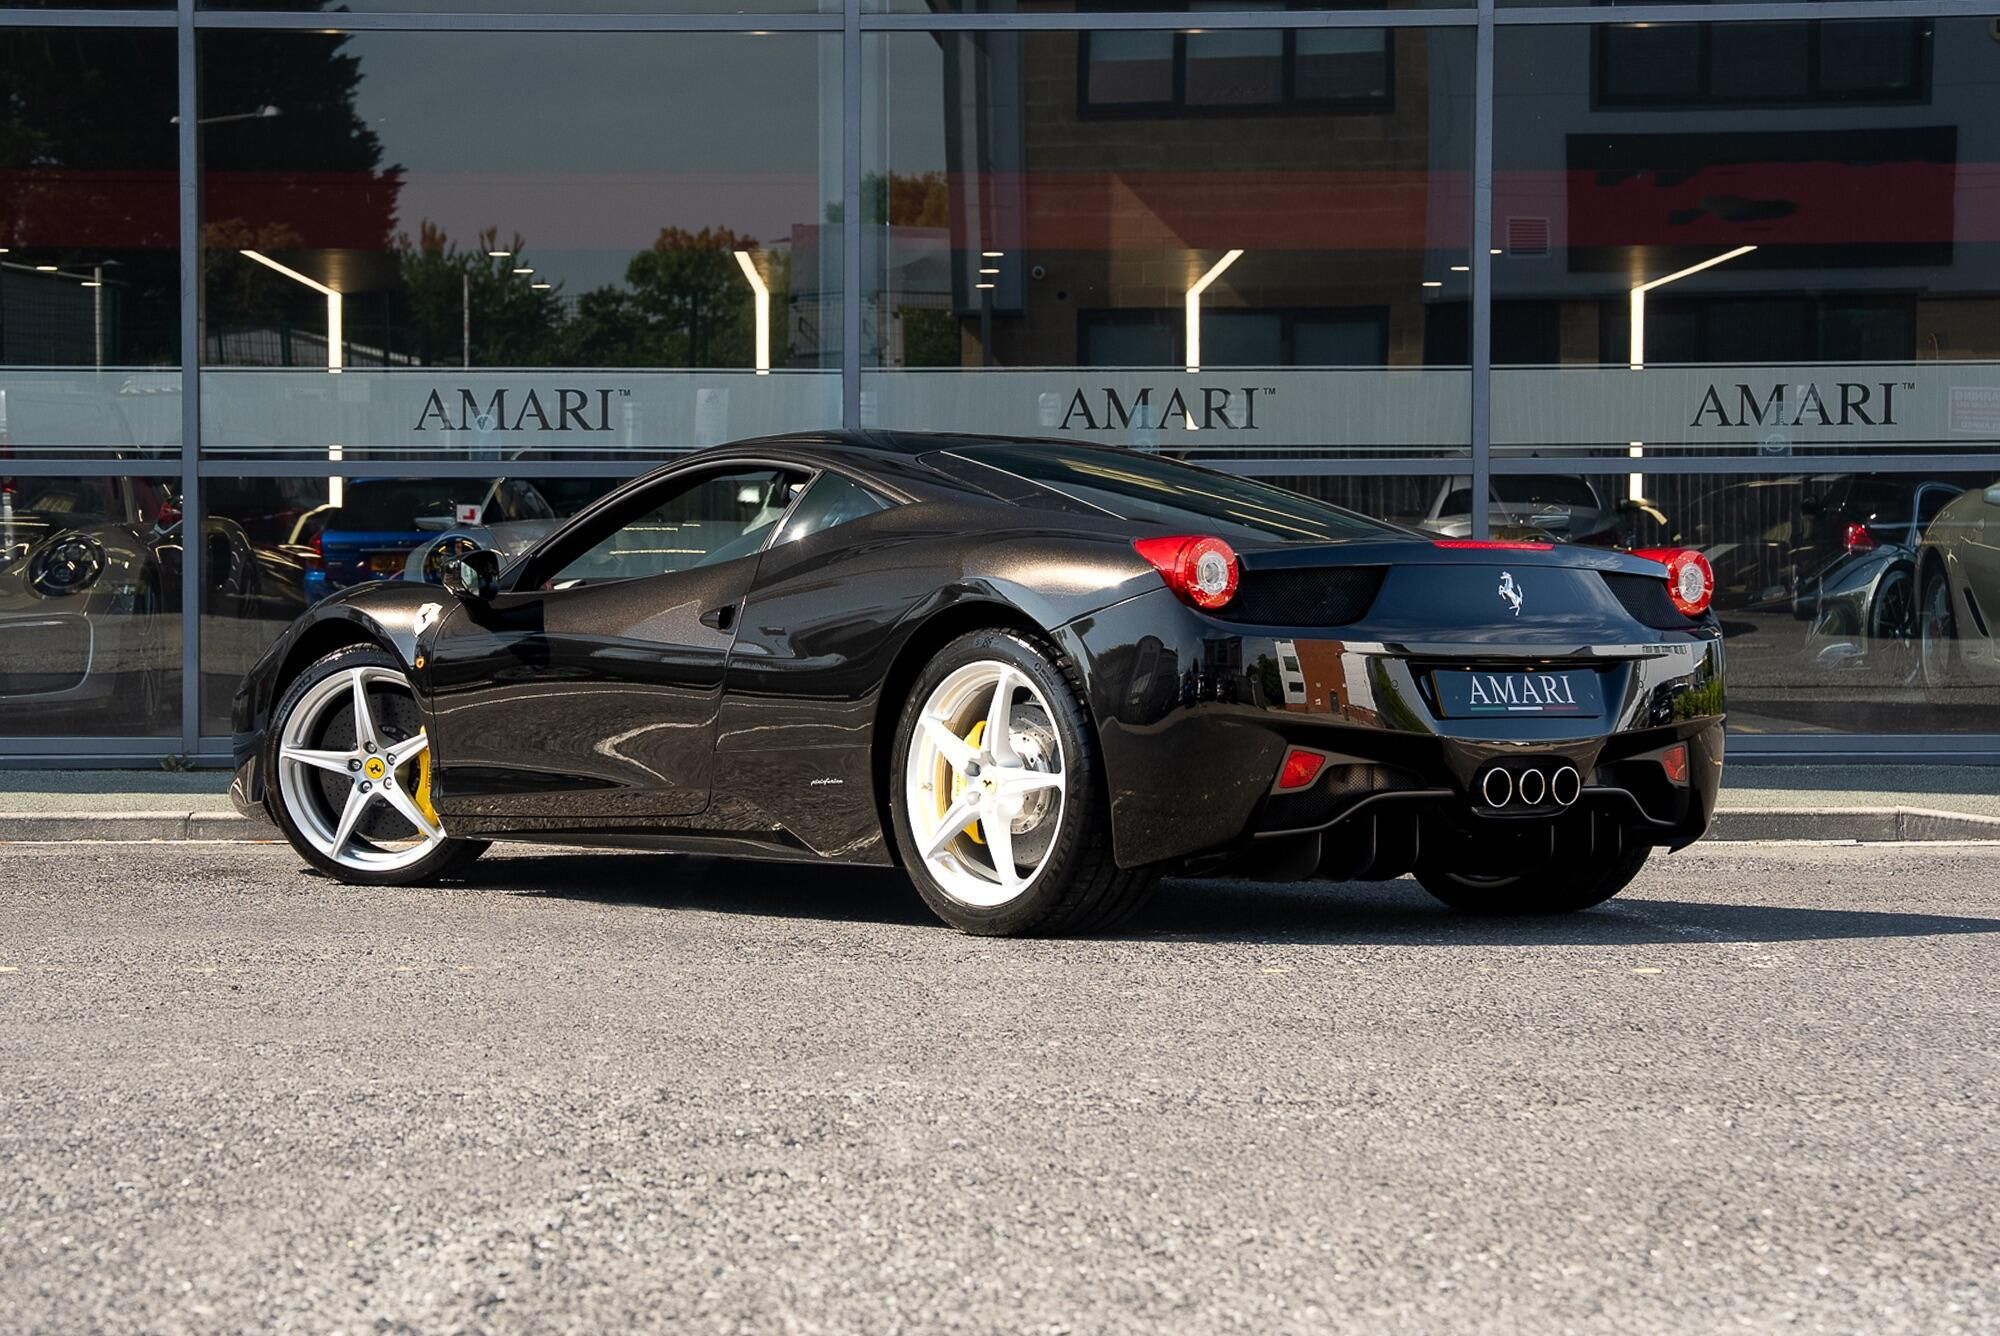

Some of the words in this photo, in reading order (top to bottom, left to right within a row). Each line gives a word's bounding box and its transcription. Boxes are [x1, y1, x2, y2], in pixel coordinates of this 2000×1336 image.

[413, 388, 615, 431] AMARI
[1057, 387, 1260, 430] AMARI
[1689, 383, 1898, 427] AMARI
[1469, 675, 1576, 704] AMARI
